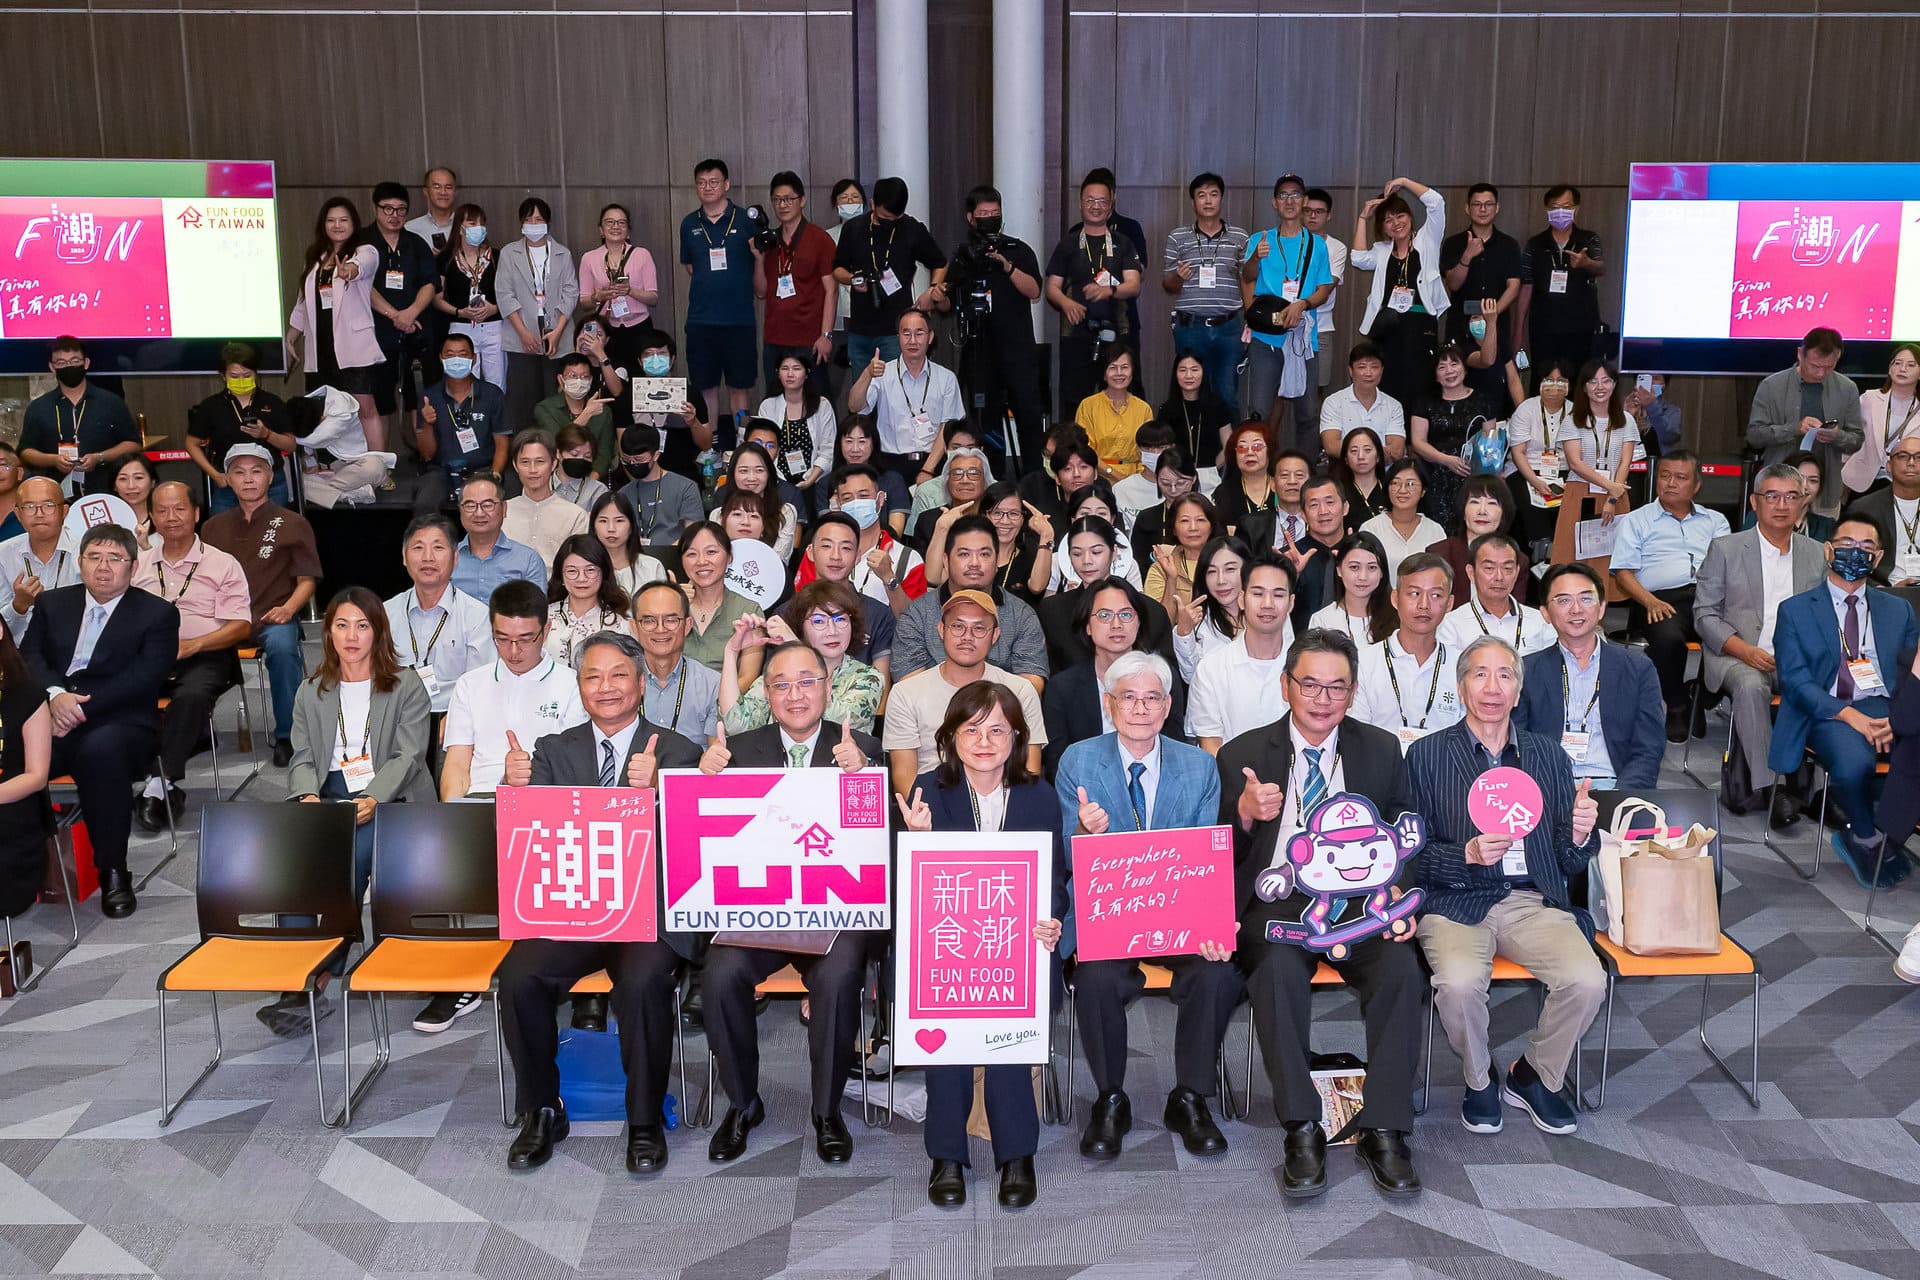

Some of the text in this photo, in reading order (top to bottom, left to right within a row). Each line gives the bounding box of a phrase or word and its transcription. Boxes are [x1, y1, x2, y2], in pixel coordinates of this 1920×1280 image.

[206, 207, 264, 217] FUN FOOD
[208, 219, 265, 229] TAIWAN
[847, 779, 877, 795] 新味
[532, 819, 624, 911] 潮
[1090, 845, 1182, 873] Everywhere,
[1088, 864, 1215, 896] Fun Food Taiwan
[932, 869, 1016, 914] 新味
[674, 910, 884, 929] FUN FOOD TAIWAN
[928, 915, 1019, 961] 食潮
[930, 967, 1015, 984] FUN FOOD
[931, 985, 1015, 1002] TAIWAN
[985, 1030, 1040, 1044] Love you.
